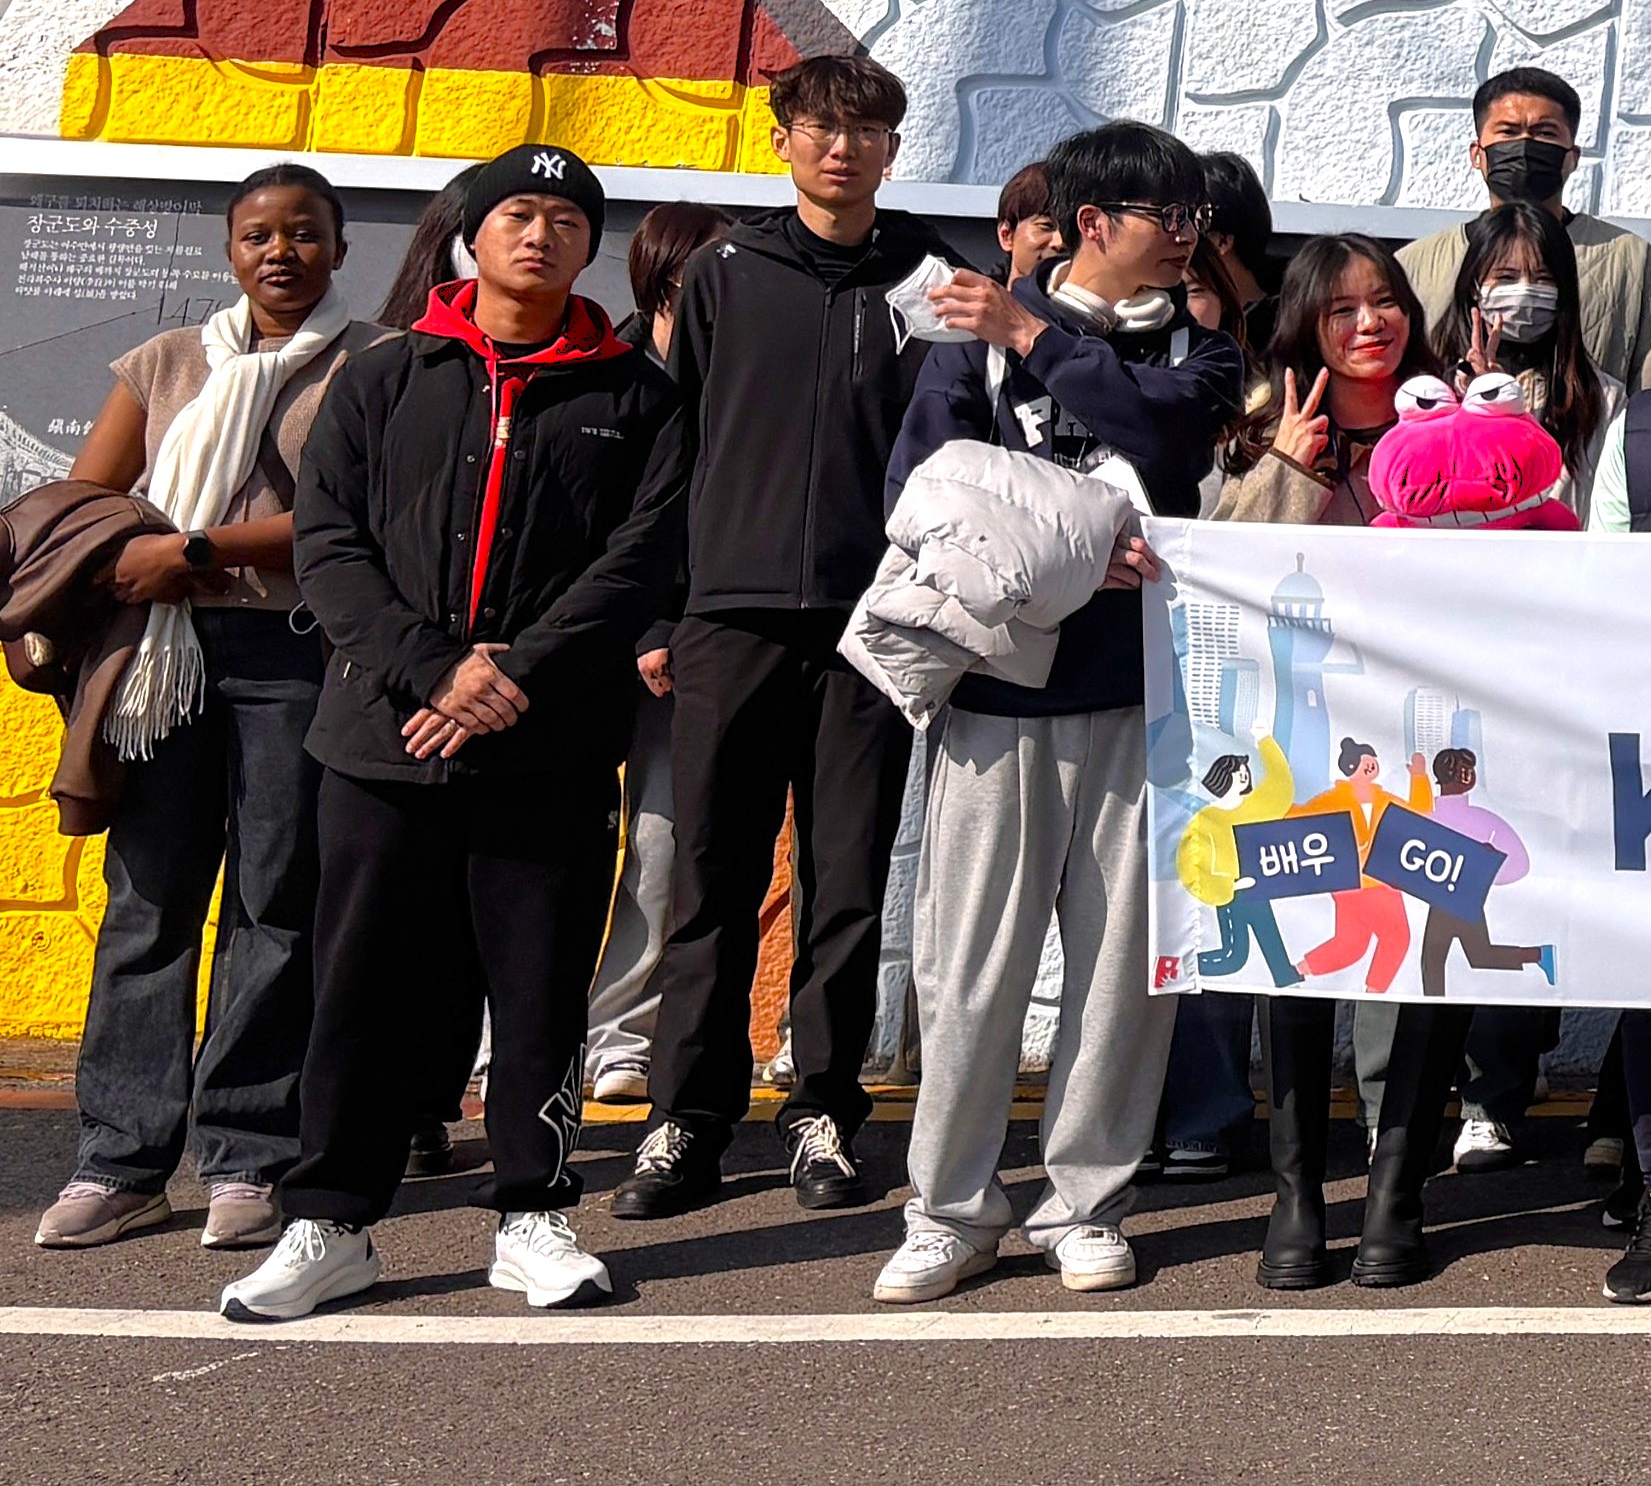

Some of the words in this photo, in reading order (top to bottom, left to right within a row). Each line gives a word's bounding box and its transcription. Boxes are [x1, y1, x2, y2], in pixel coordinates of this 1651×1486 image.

[531, 152, 567, 180] NY
[26, 213, 100, 236] 장군도와
[104, 217, 158, 239] 수중성
[1259, 832, 1335, 877] 배우
[1400, 838, 1464, 892] GO!
